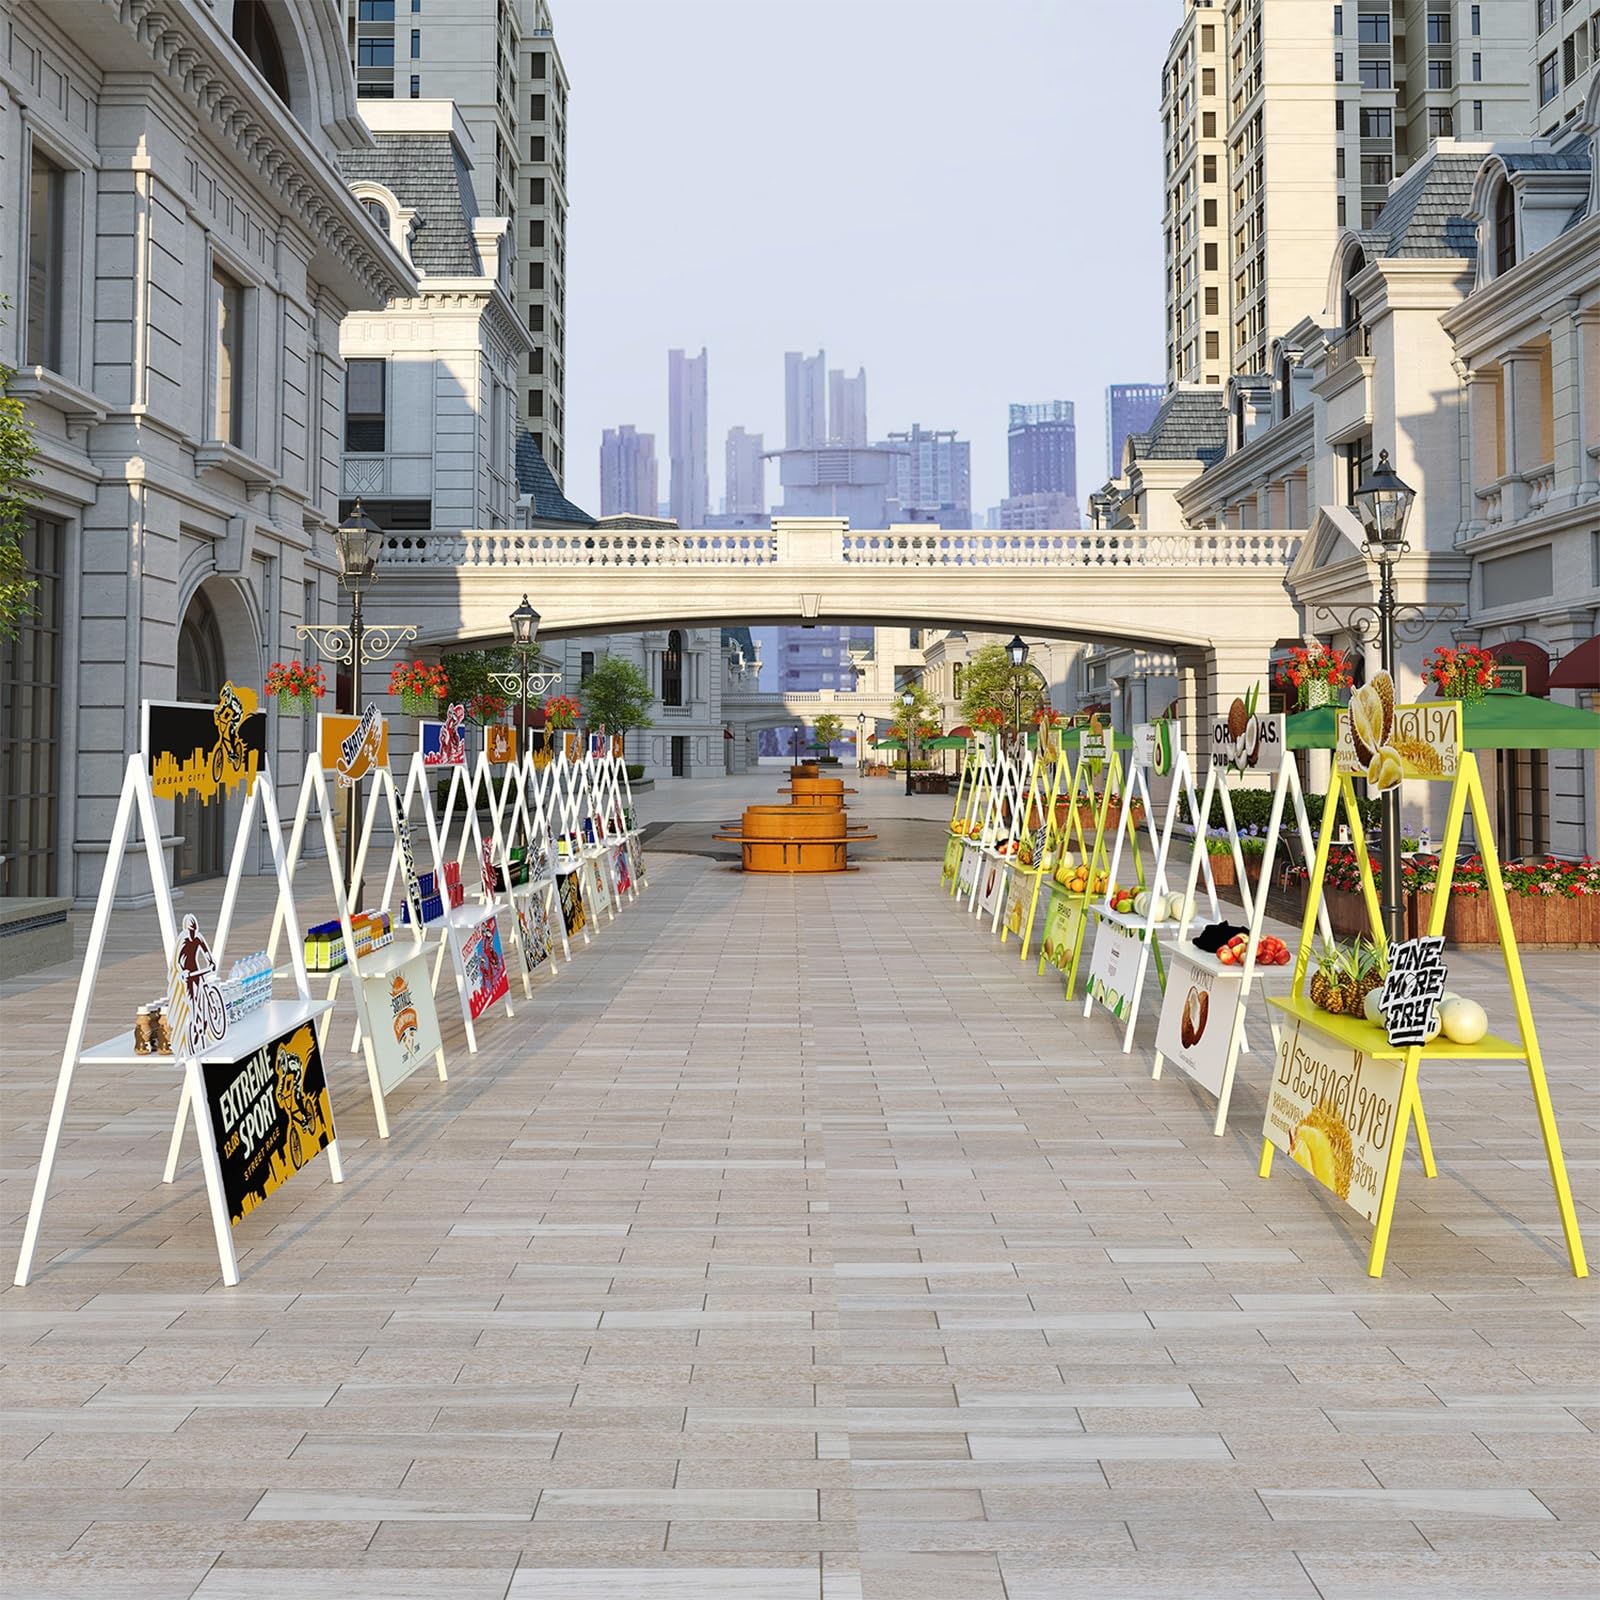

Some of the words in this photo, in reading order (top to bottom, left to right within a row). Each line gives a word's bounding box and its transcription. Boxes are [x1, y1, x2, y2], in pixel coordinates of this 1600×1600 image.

[342, 726, 364, 765] SKATE
[156, 776, 183, 785] URBAN
[188, 773, 206, 782] CITY
[1383, 969, 1443, 1003] MORE
[219, 1044, 274, 1133] EXTREME
[239, 1084, 277, 1160] SPORT
[244, 1148, 266, 1181] STREET
[265, 1126, 281, 1152] RACE
